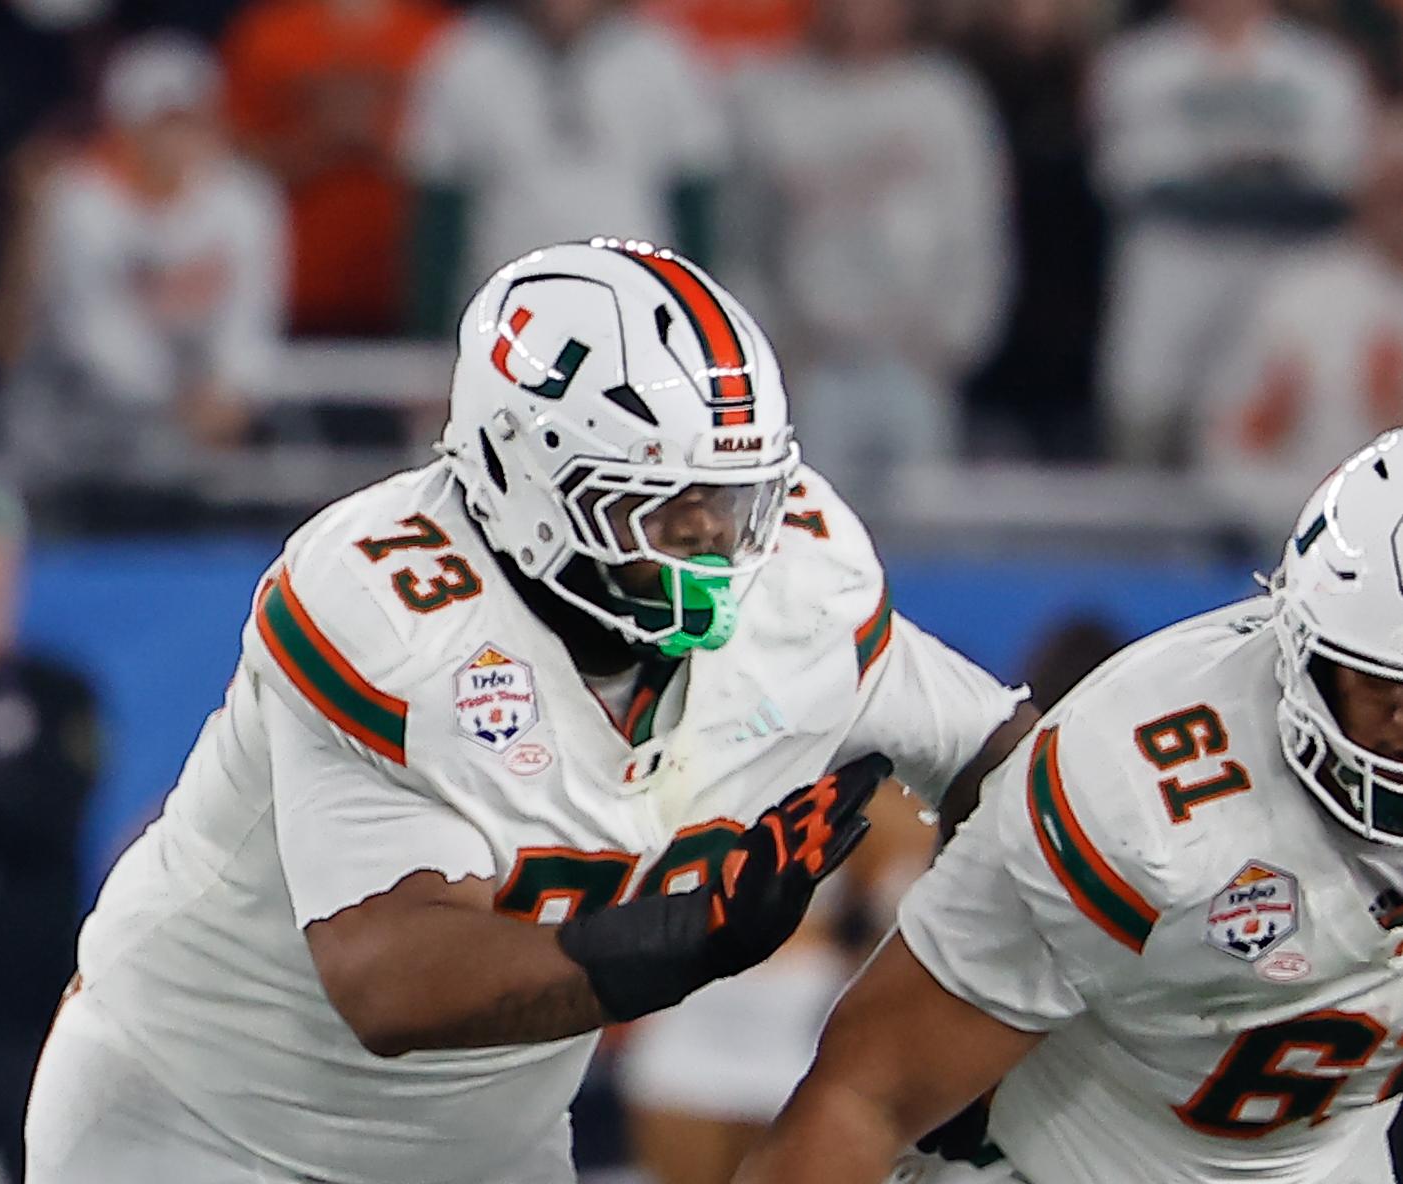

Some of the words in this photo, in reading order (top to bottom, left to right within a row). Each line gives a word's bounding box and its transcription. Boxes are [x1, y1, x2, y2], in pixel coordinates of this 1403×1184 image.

[351, 510, 483, 615] 73
[1134, 703, 1254, 825] 61
[1169, 1008, 1403, 1140] 6
